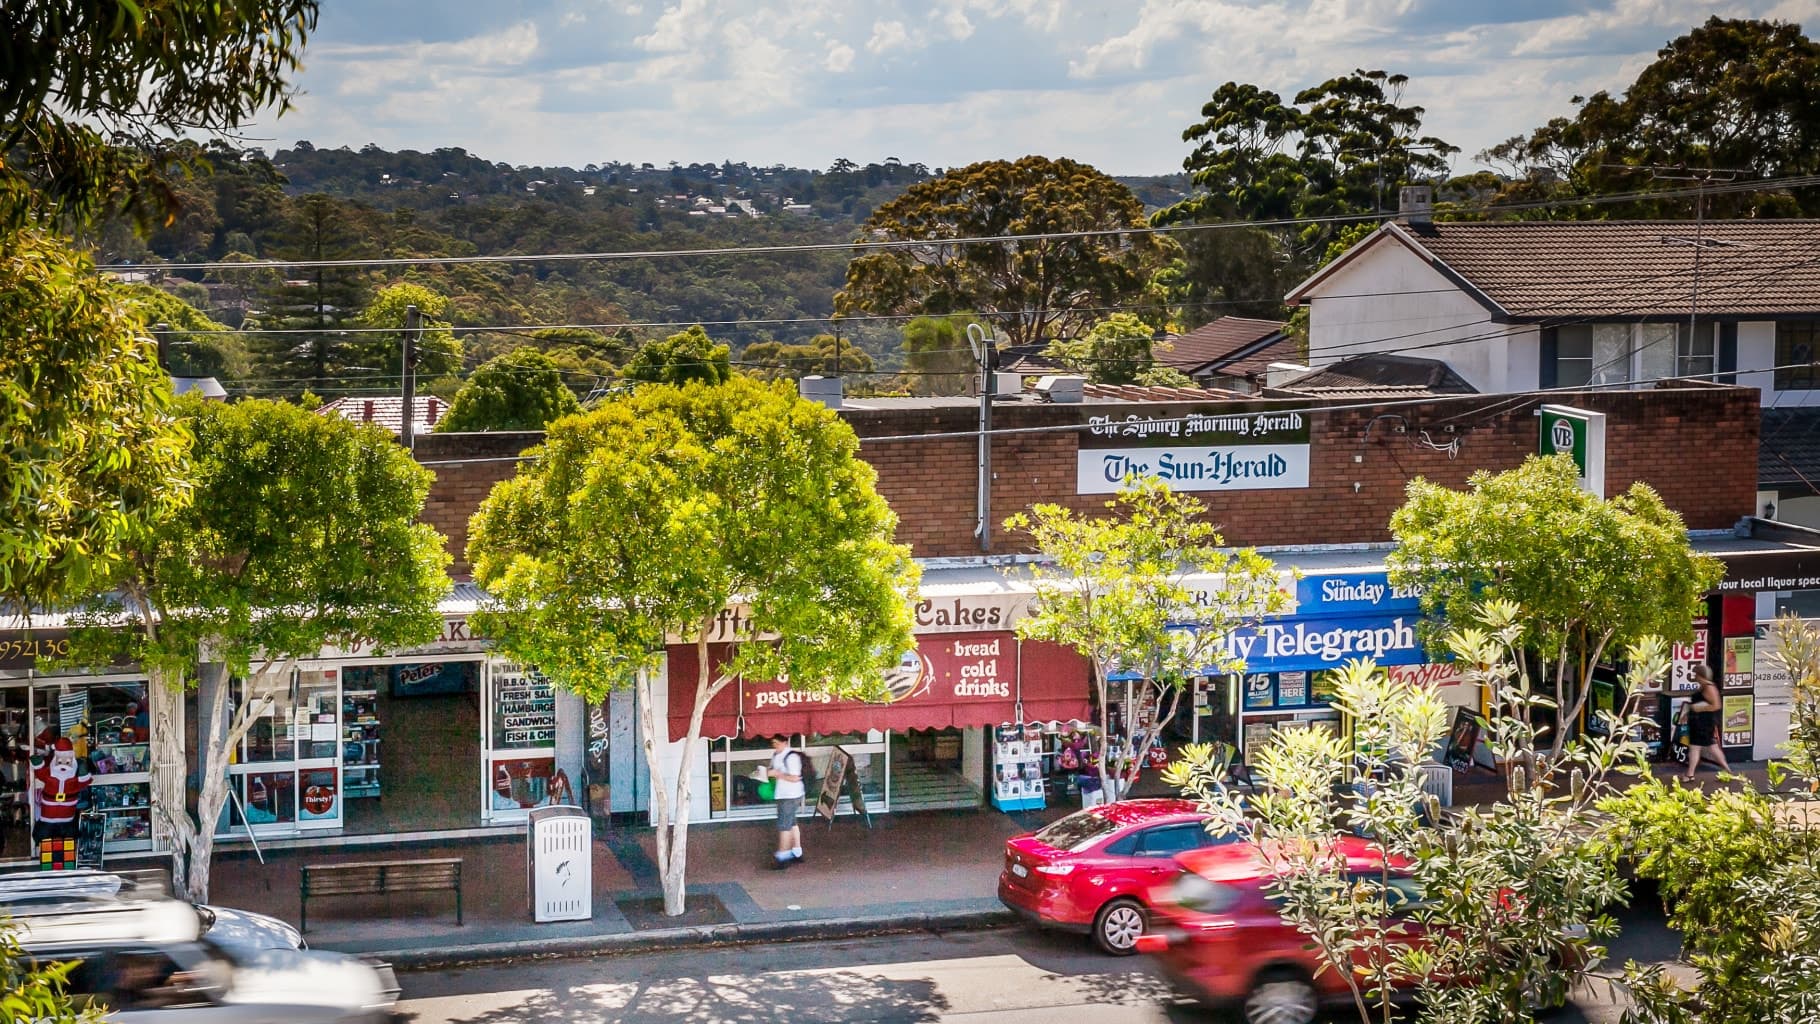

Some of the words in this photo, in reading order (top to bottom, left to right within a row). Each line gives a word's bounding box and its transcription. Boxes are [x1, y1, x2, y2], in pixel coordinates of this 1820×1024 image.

[1089, 415, 1118, 438] The
[1123, 414, 1180, 437] Sydney
[1185, 413, 1249, 436] Morning
[1253, 413, 1302, 437] Herald
[1553, 427, 1572, 446] VB
[1103, 454, 1148, 483] The
[1158, 450, 1287, 485] Sun-Herald
[1322, 580, 1385, 605] Sunday
[1740, 577, 1764, 589] local
[1767, 577, 1796, 589] liquor
[914, 598, 1001, 627] Cakes
[954, 639, 1000, 657] bread
[1257, 617, 1415, 662] Telegraph
[1674, 642, 1706, 660] ICE
[960, 659, 998, 678] cold
[954, 678, 1010, 697] drinks
[1247, 673, 1270, 691] 15
[503, 691, 531, 700] FRESH
[755, 688, 832, 709] pastries
[1280, 688, 1305, 697] HERE
[506, 717, 556, 728] SANDWICH
[507, 732, 528, 741] FISH
[529, 732, 535, 740] &
